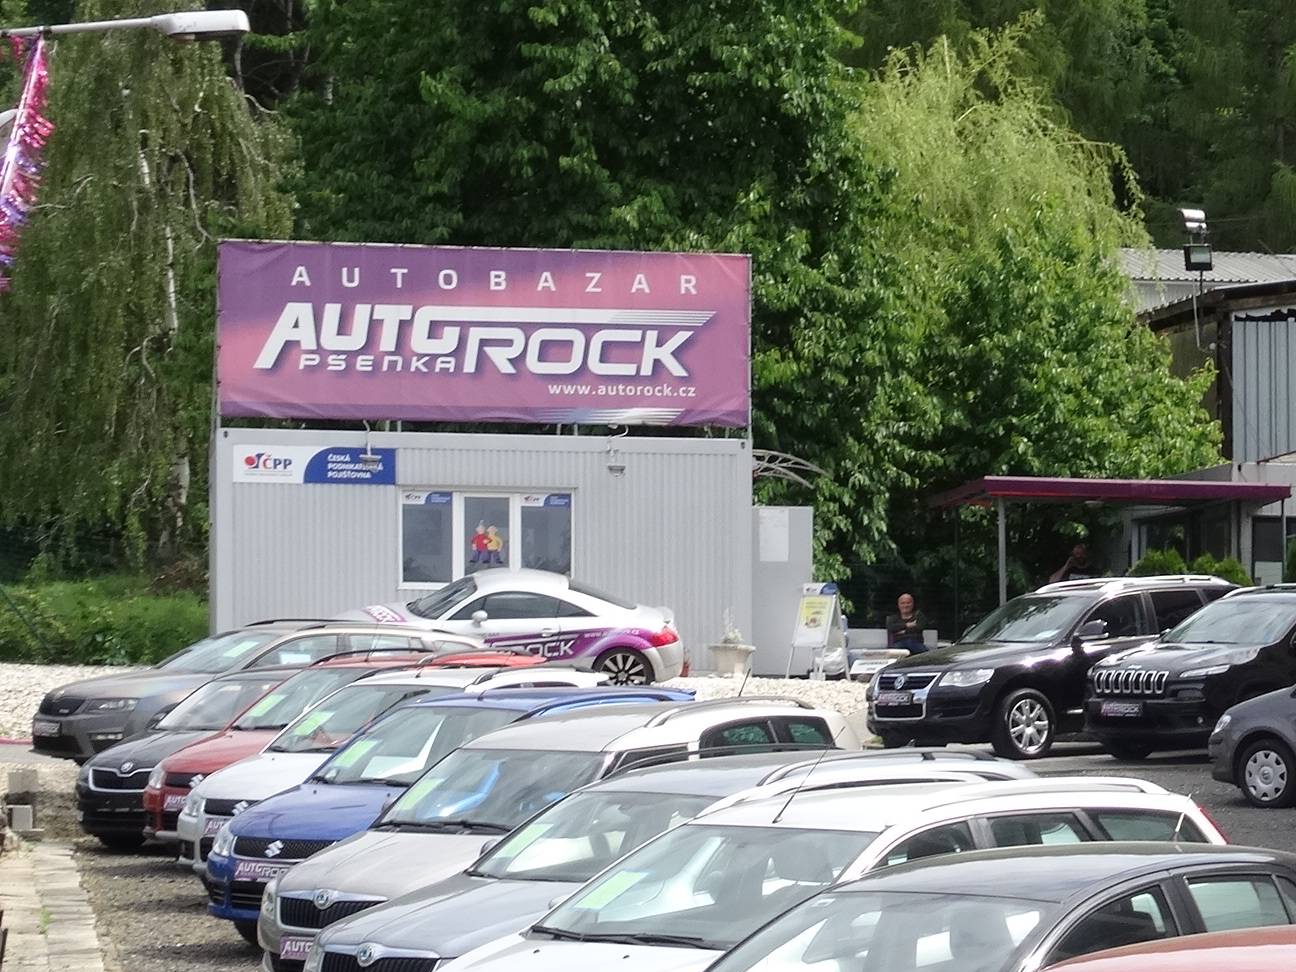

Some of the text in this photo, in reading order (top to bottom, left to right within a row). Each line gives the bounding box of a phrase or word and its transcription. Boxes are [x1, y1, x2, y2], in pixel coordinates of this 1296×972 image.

[291, 265, 697, 295] AUTOBAZAR
[254, 302, 716, 377] AUTOROCK
[547, 381, 697, 398] www.autorock.cz
